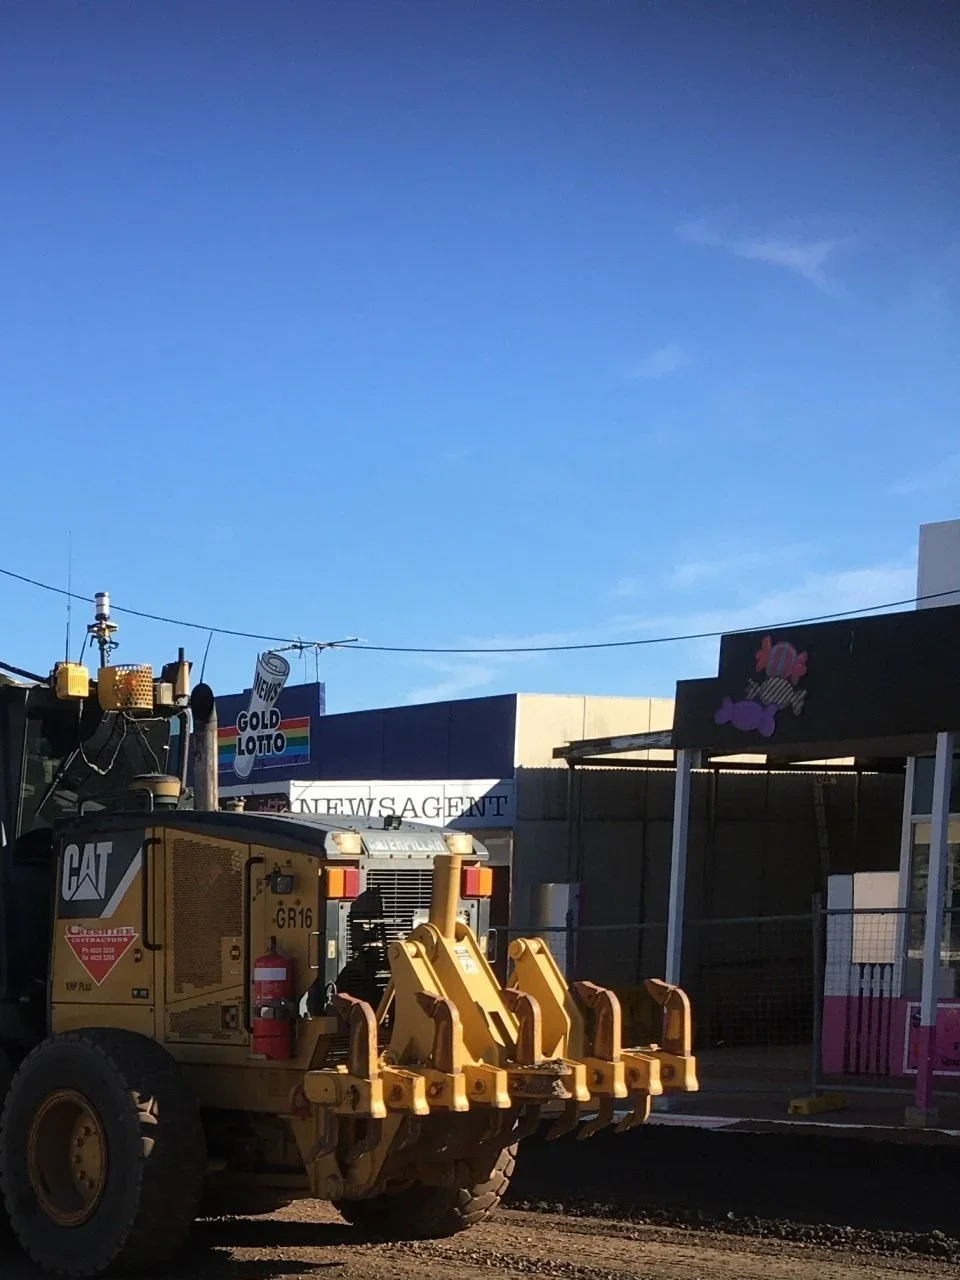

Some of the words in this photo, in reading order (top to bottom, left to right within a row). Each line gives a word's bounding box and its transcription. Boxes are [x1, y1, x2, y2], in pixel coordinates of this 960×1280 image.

[255, 672, 282, 703] NEWS
[237, 710, 280, 733] GOLD
[237, 733, 285, 756] LOTTO
[297, 795, 508, 820] NEWSAGENT
[368, 838, 445, 852] CATERPILLAR
[61, 841, 113, 901] CAT
[276, 907, 313, 929] GR16
